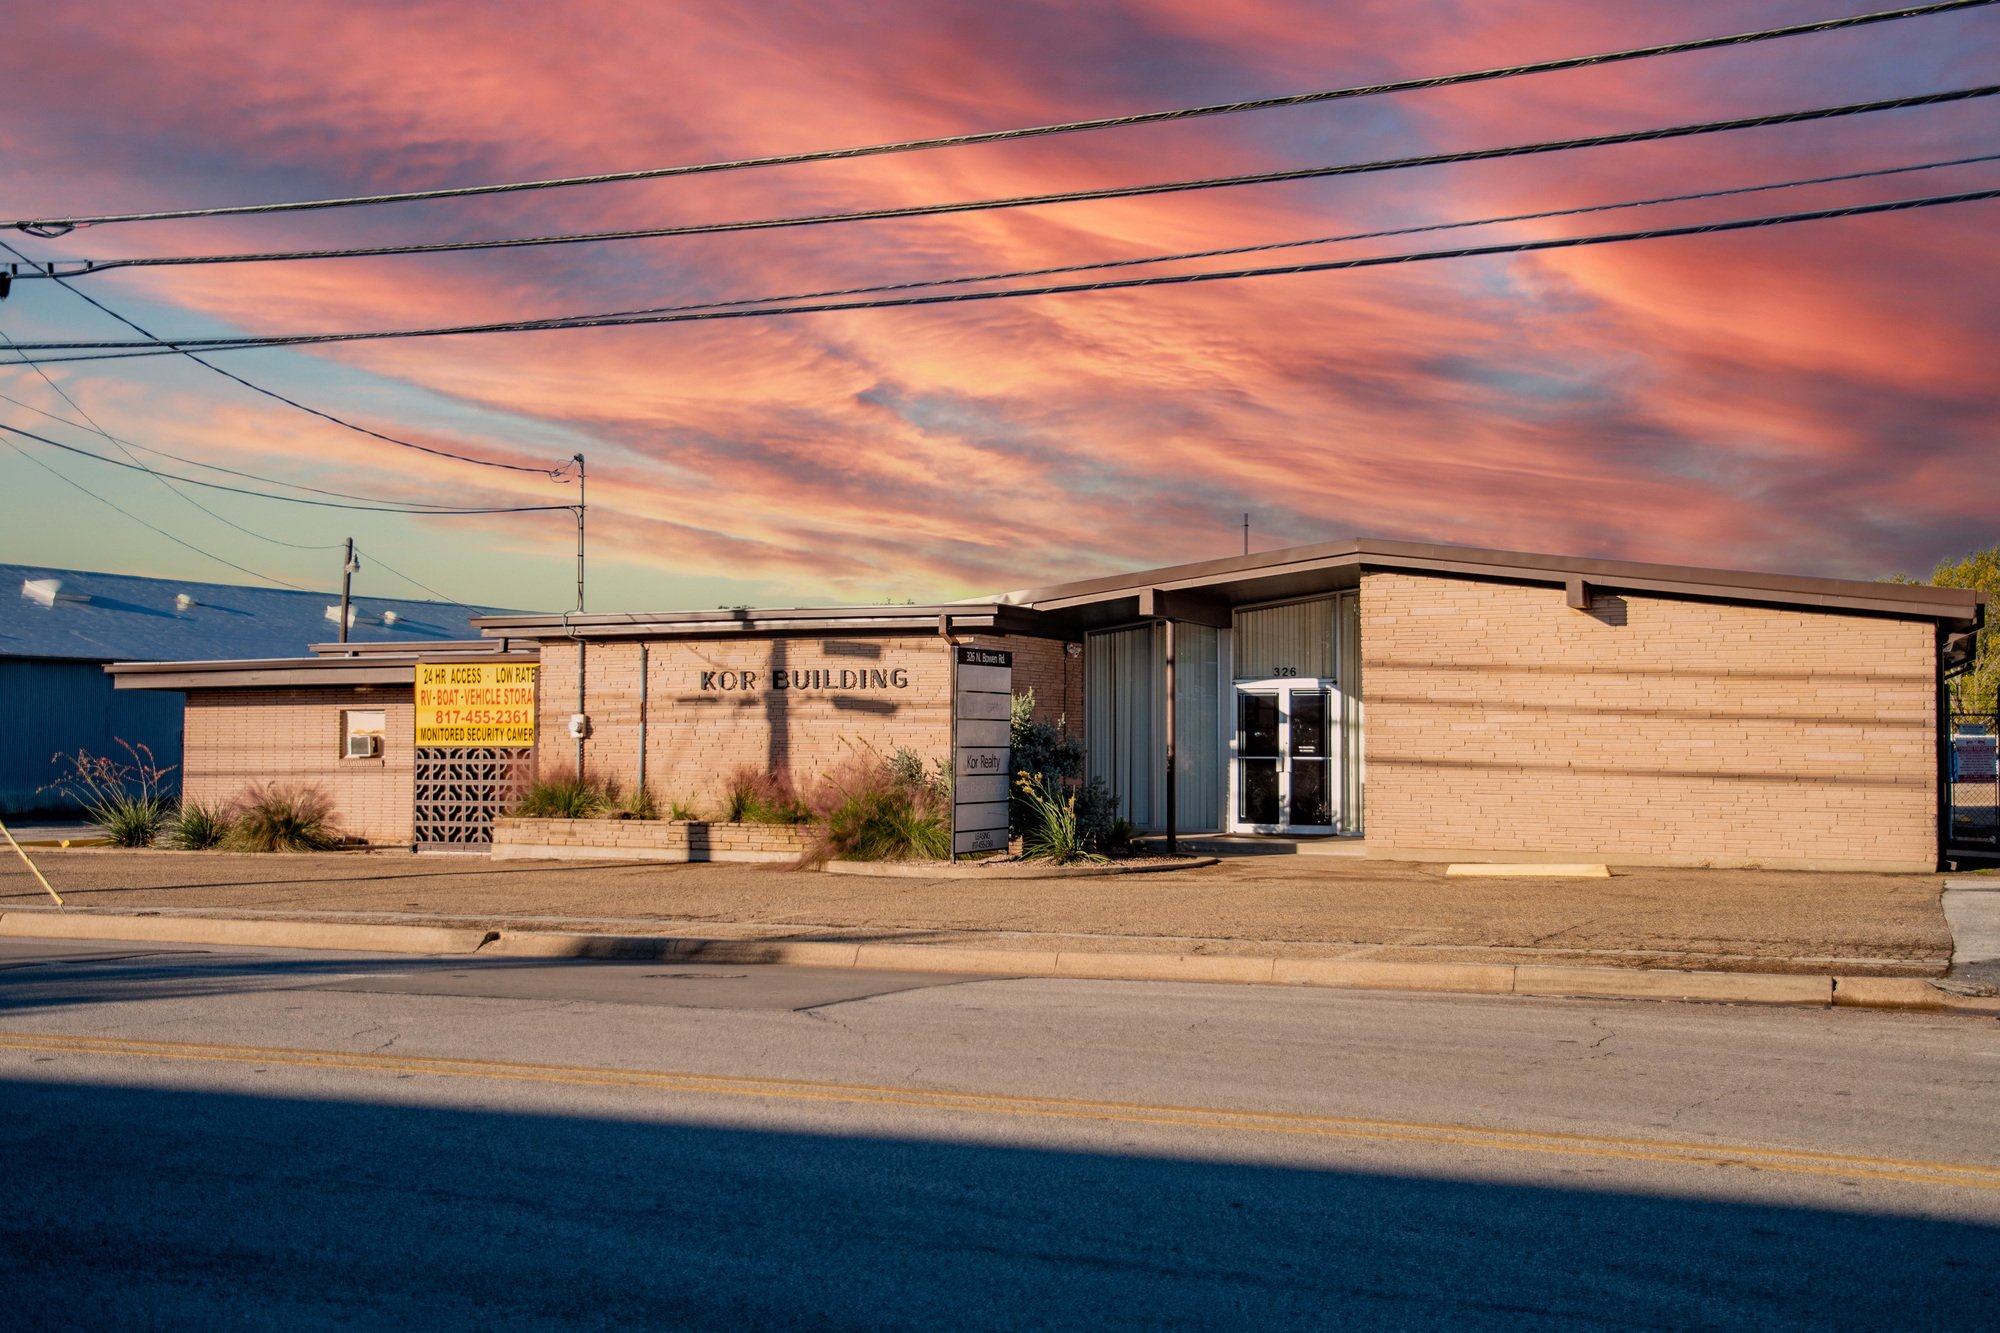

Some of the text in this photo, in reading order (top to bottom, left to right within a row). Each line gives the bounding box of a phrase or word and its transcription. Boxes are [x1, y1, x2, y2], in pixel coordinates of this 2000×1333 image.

[966, 651, 975, 662] 326
[982, 652, 998, 664] Bowen
[424, 668, 433, 684] 24
[435, 668, 446, 684] HR
[451, 668, 481, 683] ACCESS
[496, 667, 514, 683] LOW
[1273, 667, 1297, 677] 326
[700, 668, 909, 691] KOR BUILDING
[435, 710, 529, 724] 817-455-2361
[420, 728, 465, 741] MONITORED
[467, 728, 505, 741] SECURITY
[967, 754, 1000, 771] Kor Realty
[975, 832, 990, 840] LEASING
